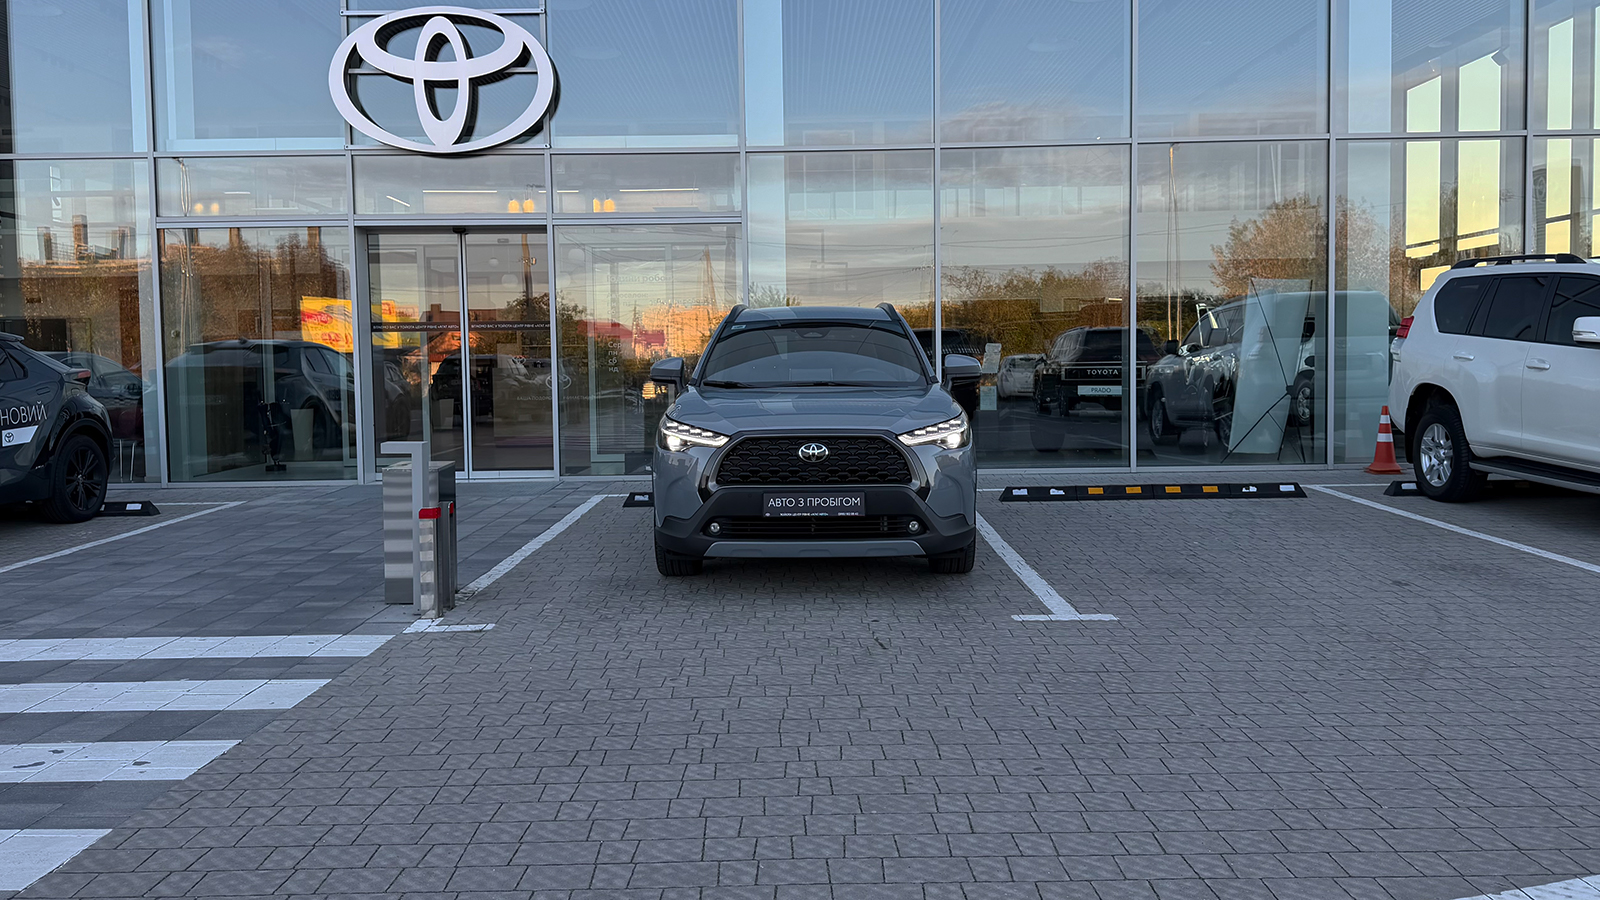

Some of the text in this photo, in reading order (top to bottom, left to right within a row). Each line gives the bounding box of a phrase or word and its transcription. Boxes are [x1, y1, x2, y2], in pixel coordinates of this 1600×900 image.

[0, 400, 47, 426] НОВИЙ
[768, 497, 861, 507] АВТО З ПРОБІГОМ
